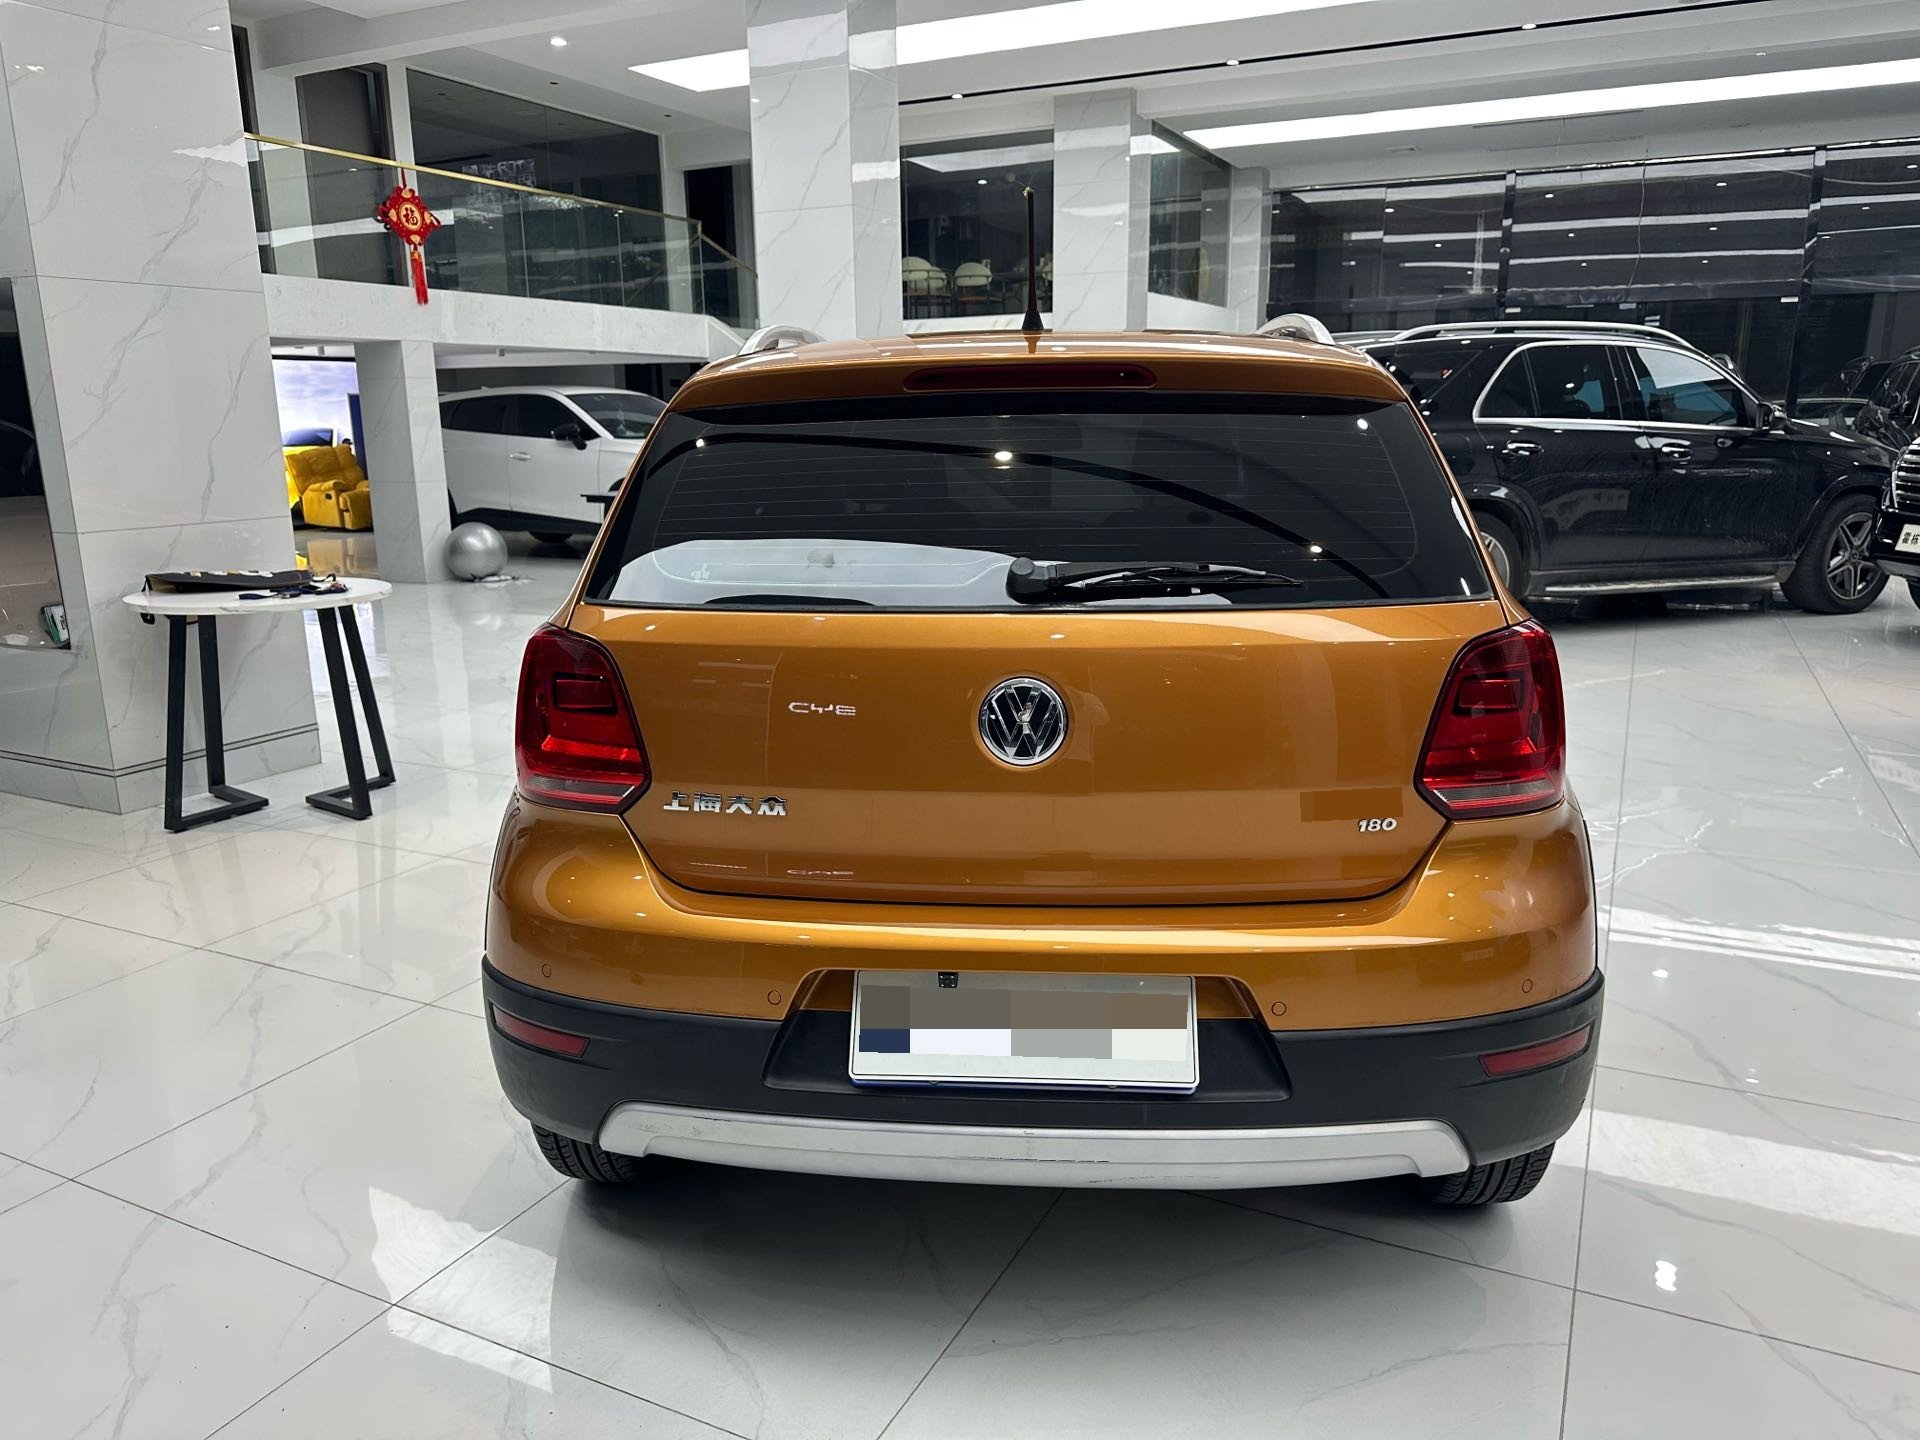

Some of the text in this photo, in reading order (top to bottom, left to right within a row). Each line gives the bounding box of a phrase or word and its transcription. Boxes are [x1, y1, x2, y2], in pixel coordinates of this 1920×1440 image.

[402, 206, 419, 226] 福
[662, 789, 788, 816] 上海大众
[1358, 817, 1398, 832] 180
